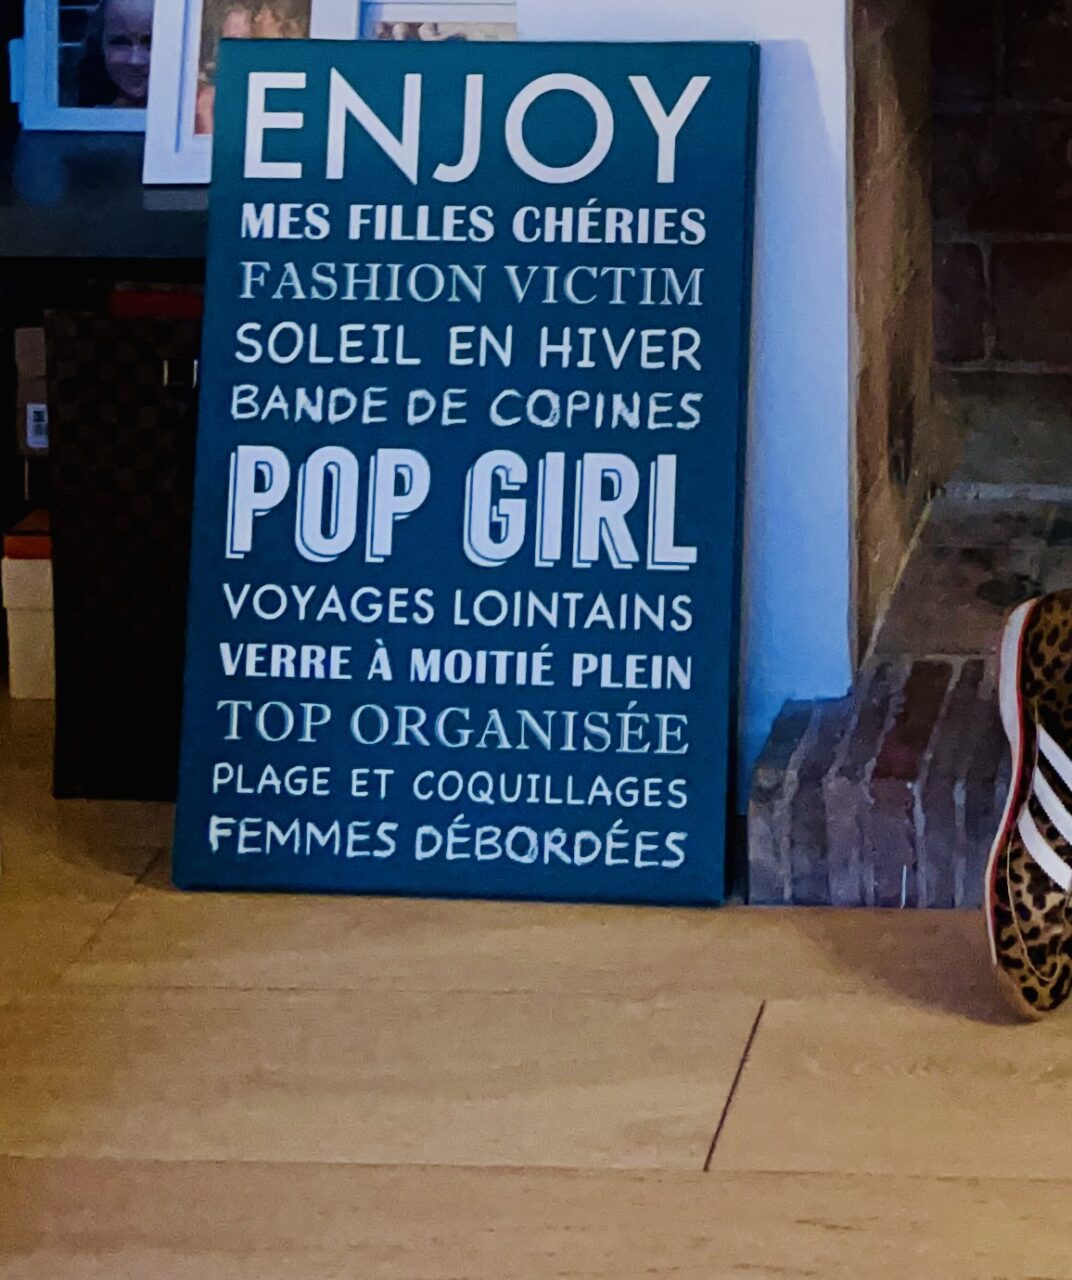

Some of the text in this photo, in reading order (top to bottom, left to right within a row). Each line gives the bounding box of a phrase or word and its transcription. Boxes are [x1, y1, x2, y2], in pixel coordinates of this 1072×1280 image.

[244, 68, 710, 184] ENJOY
[242, 199, 705, 244] MES FILLES CHÉRIES
[241, 262, 703, 305] FASHION VICTIM
[236, 322, 701, 370] SOLEIL EN HIVER
[232, 385, 702, 429] BANDE DE COPINES
[226, 446, 697, 570] POP GIRL
[224, 584, 692, 631] VOYAGES LOINTAINS
[220, 639, 691, 689] VERRE À MOITIÉ PLEIN
[217, 701, 688, 753] TOP ORGANISÉE
[214, 763, 687, 808] PLAGE ET COQUILLAGES
[210, 814, 686, 867] FEMMES DÉBORDÉES
